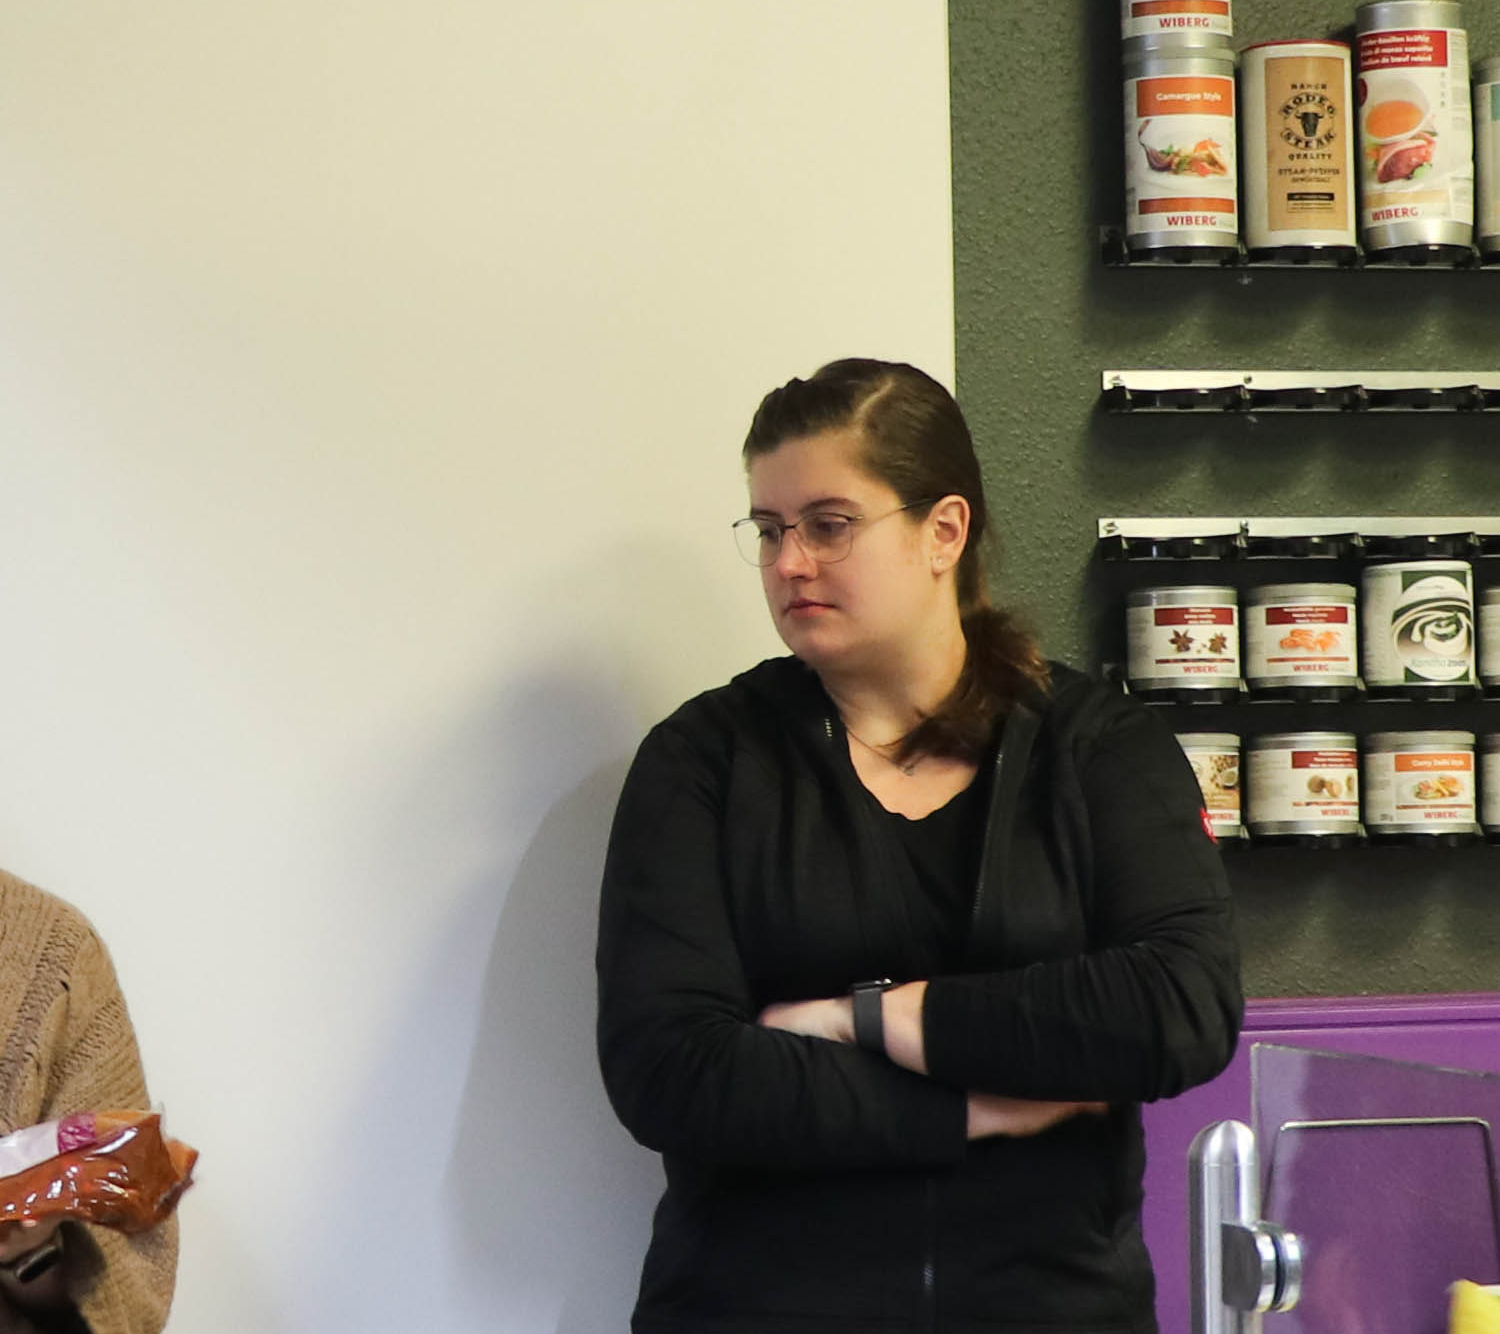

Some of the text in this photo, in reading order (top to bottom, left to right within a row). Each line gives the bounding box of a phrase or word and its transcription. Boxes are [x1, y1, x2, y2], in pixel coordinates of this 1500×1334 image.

[1160, 17, 1209, 28] WIBERG
[1156, 92, 1221, 102] Camargue Style
[1281, 129, 1336, 150] STEAK
[1371, 208, 1418, 221] WIBERG
[1167, 216, 1217, 226] WIBERG
[1183, 666, 1218, 674] WIBERG
[1293, 664, 1329, 672] WIBERG
[1424, 811, 1458, 819] WIBERG
